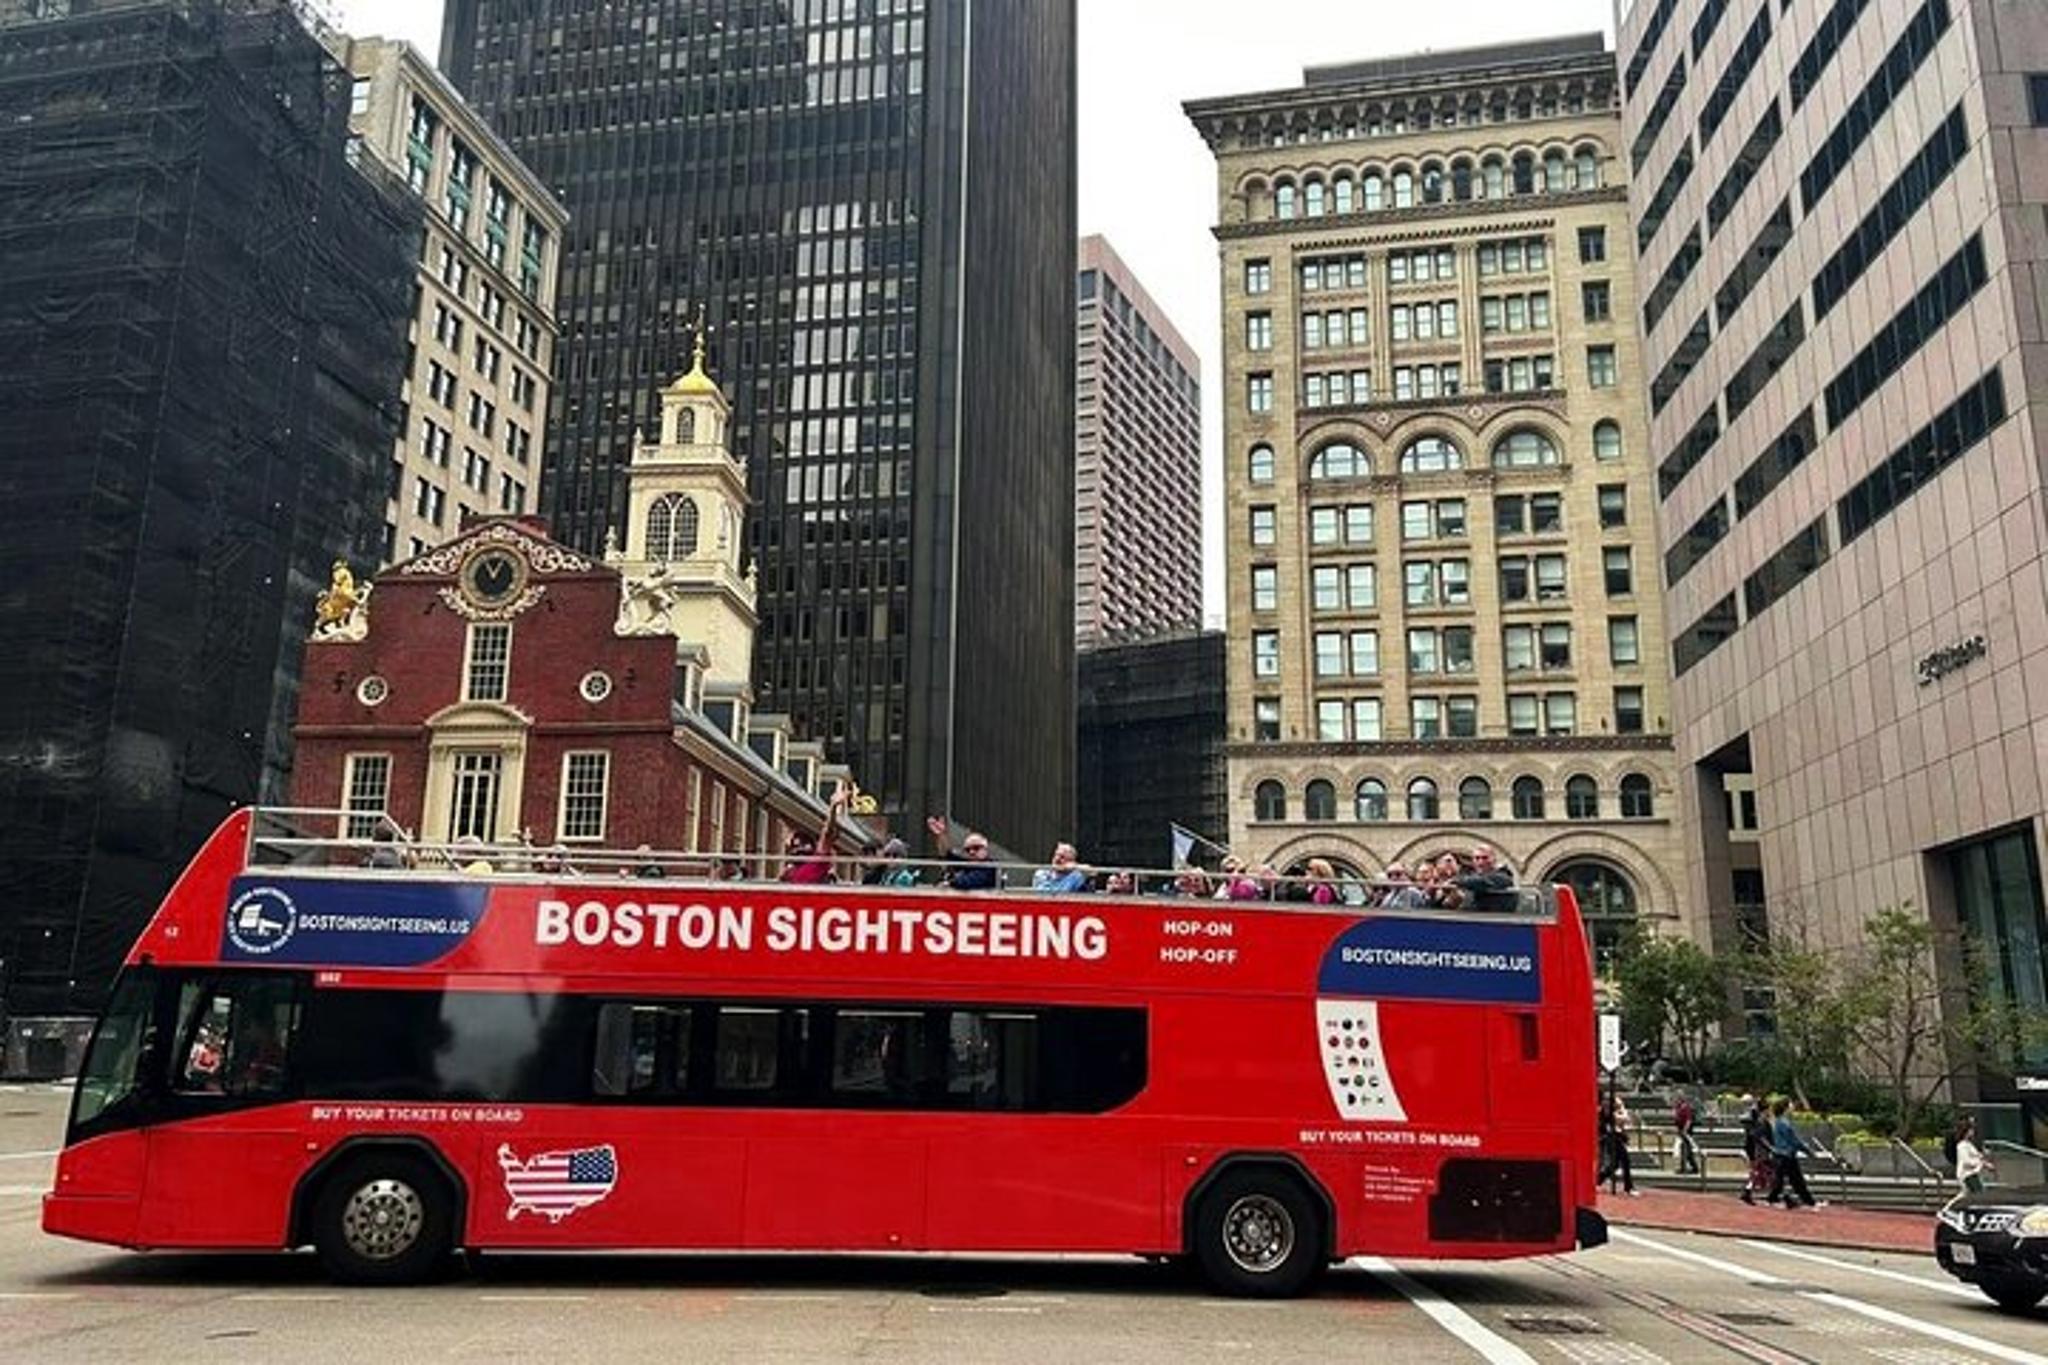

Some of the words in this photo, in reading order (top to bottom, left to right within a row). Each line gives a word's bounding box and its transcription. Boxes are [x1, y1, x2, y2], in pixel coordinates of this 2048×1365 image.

[298, 914, 471, 935] BOSTONSIGHTSEEING.US
[535, 899, 753, 950] BOSTON
[765, 906, 1108, 961] SIGHTSEEING
[1163, 920, 1233, 938] HOP-ON
[1159, 946, 1238, 965] HOP-OFF
[1341, 946, 1532, 972] BOSTONSIGHTSEEING.US
[311, 1106, 342, 1120] BUY
[346, 1106, 385, 1121] YOUR
[388, 1107, 447, 1121] TICKETS
[451, 1108, 473, 1122] ON
[475, 1108, 524, 1122] BOARD
[1299, 1130, 1326, 1143] BUY
[1329, 1131, 1363, 1144] YOUR
[1365, 1131, 1416, 1145] TICKETS
[1419, 1132, 1438, 1145] ON
[1439, 1133, 1482, 1148] BOARD
